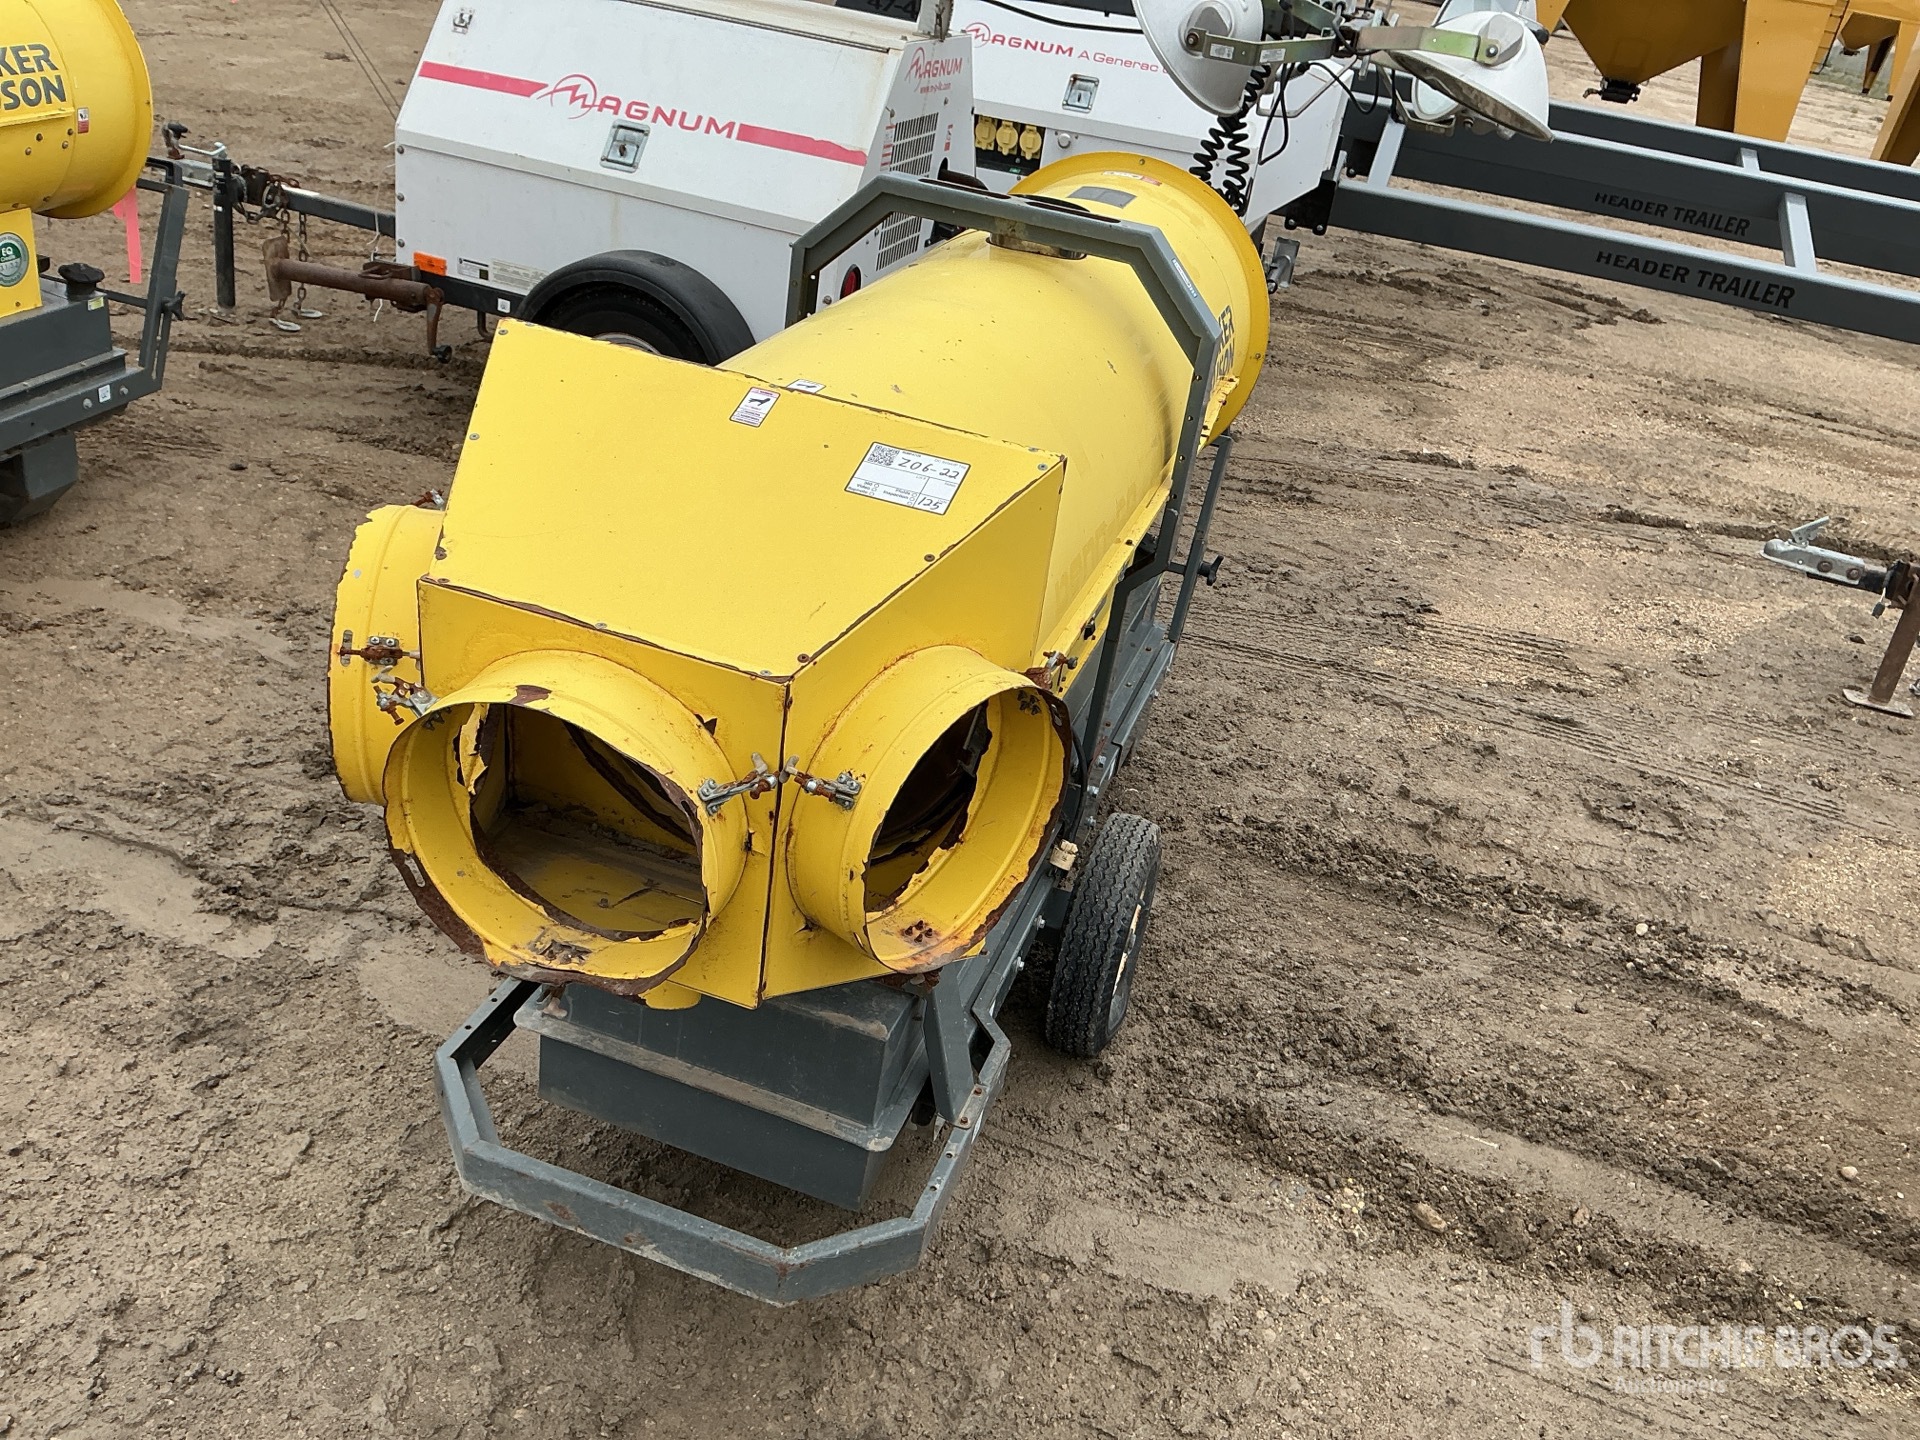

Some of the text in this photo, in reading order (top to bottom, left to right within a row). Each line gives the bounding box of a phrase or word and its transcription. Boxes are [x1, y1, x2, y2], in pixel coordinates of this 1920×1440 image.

[904, 48, 963, 82] MAGNUM
[966, 22, 1074, 57] MAGNUM
[1077, 50, 1091, 61] A
[1093, 52, 1159, 73] Generac
[0, 74, 67, 111] SON
[536, 75, 736, 139] MAGNUM
[1595, 192, 1751, 237] HEADER TRAILER
[1596, 250, 1796, 309] HEADER TRAILER
